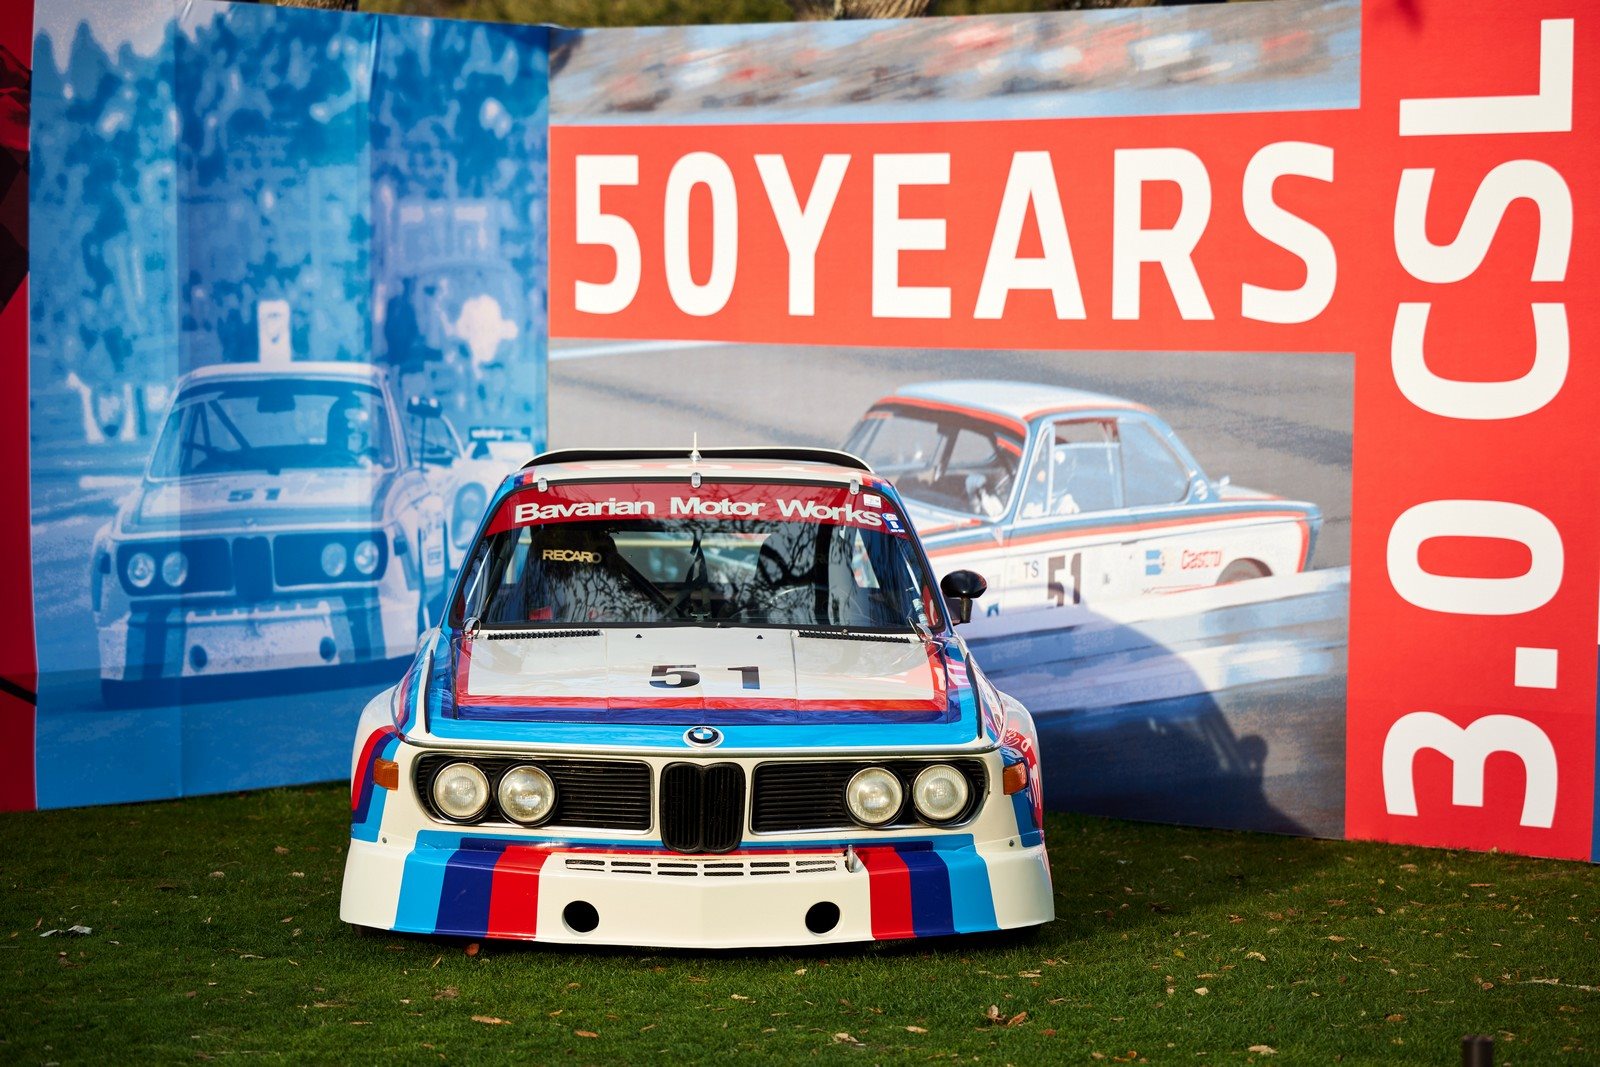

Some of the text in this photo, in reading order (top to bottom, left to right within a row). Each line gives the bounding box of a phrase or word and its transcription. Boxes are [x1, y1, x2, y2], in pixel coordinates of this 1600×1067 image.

[1382, 18, 1575, 829] 3.0 CSL
[228, 488, 281, 502] 51
[514, 497, 656, 523] Bavarian
[670, 496, 767, 516] Motor
[776, 498, 883, 526] Works
[542, 549, 602, 564] RECARO
[1023, 560, 1040, 578] TS
[1046, 552, 1082, 607] 51
